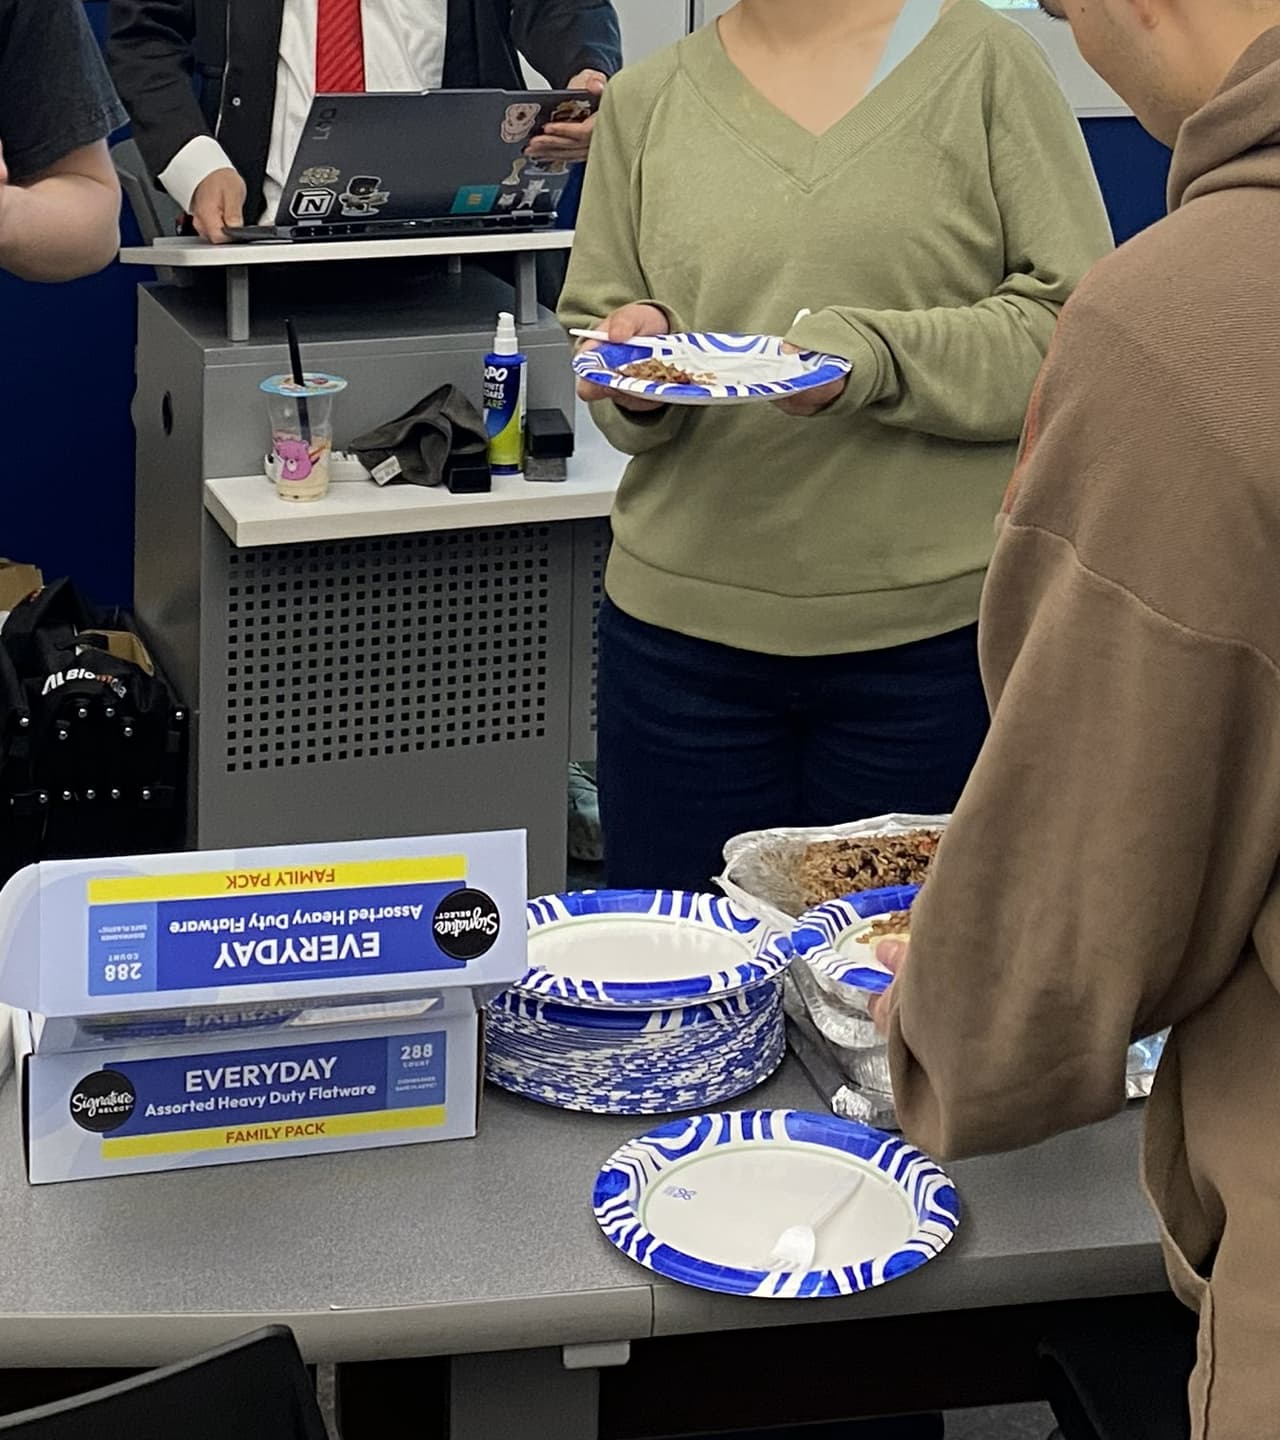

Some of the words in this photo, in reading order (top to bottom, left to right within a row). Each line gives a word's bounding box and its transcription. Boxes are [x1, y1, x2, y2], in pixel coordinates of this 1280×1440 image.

[226, 873, 270, 890] PACK
[275, 868, 335, 886] FAMILY
[293, 909, 346, 926] Heavy
[349, 904, 423, 921] Assorted
[434, 906, 498, 937] Signature
[169, 917, 245, 934] Flatware
[248, 913, 289, 931] Duty
[108, 953, 139, 962] COUNT
[213, 932, 381, 970] EVERYDAY
[104, 962, 143, 982] 288
[400, 1043, 433, 1060] 288
[185, 1056, 338, 1093] EVERYDAY
[72, 1090, 134, 1117] Signature
[145, 1097, 215, 1117] Assorted
[218, 1093, 266, 1110] Heavy
[270, 1090, 306, 1105] Duty
[309, 1084, 377, 1100] Flatware
[226, 1126, 282, 1144] FAMILY
[285, 1122, 325, 1139] PACK
